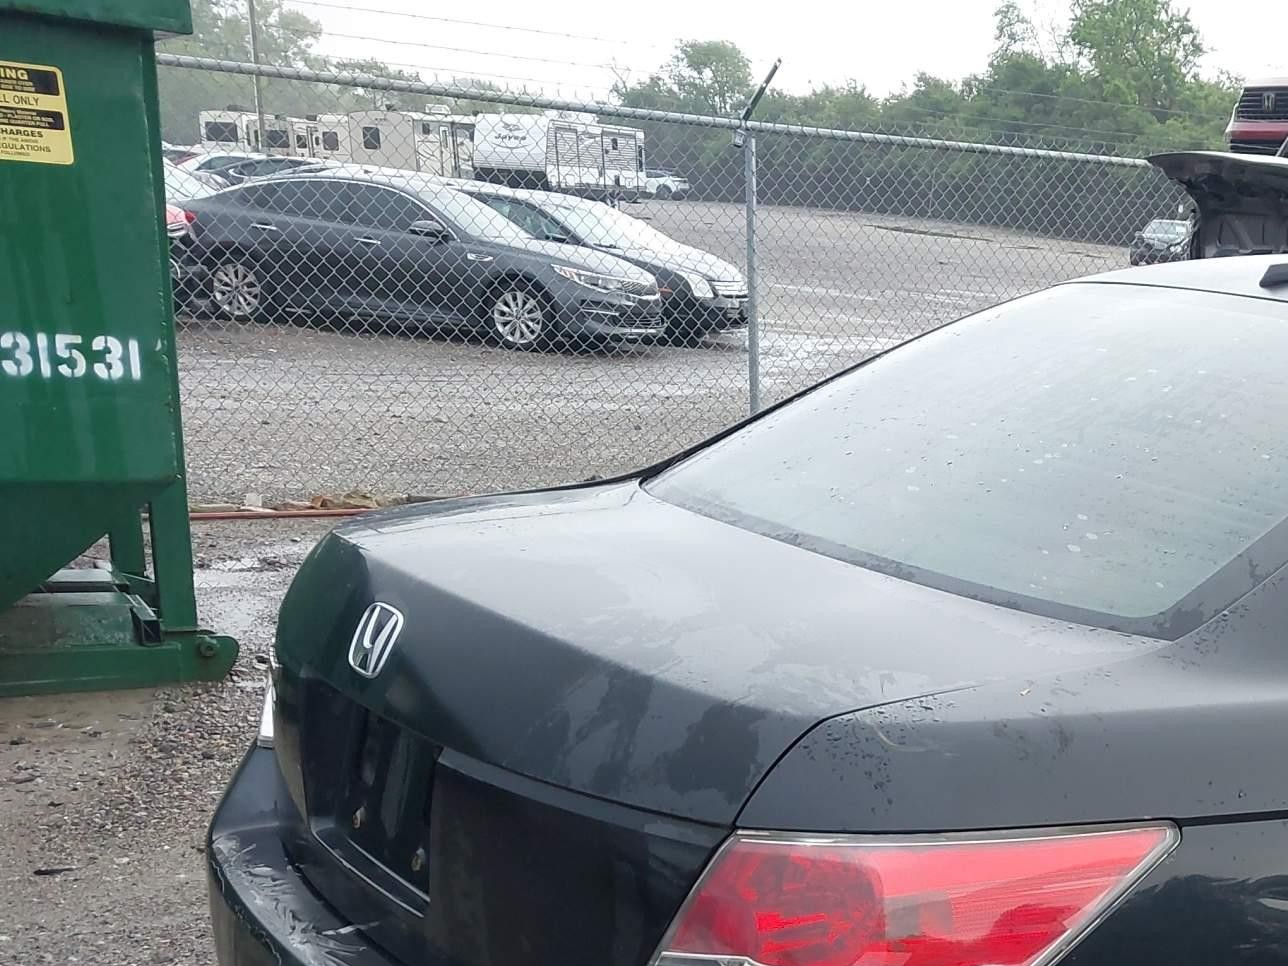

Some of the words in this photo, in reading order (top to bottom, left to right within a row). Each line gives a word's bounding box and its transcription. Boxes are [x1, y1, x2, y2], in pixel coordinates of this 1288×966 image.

[12, 94, 39, 107] ONLY
[0, 127, 43, 138] HARGES
[0, 142, 52, 153] GULATIONS
[0, 331, 141, 381] 31531
